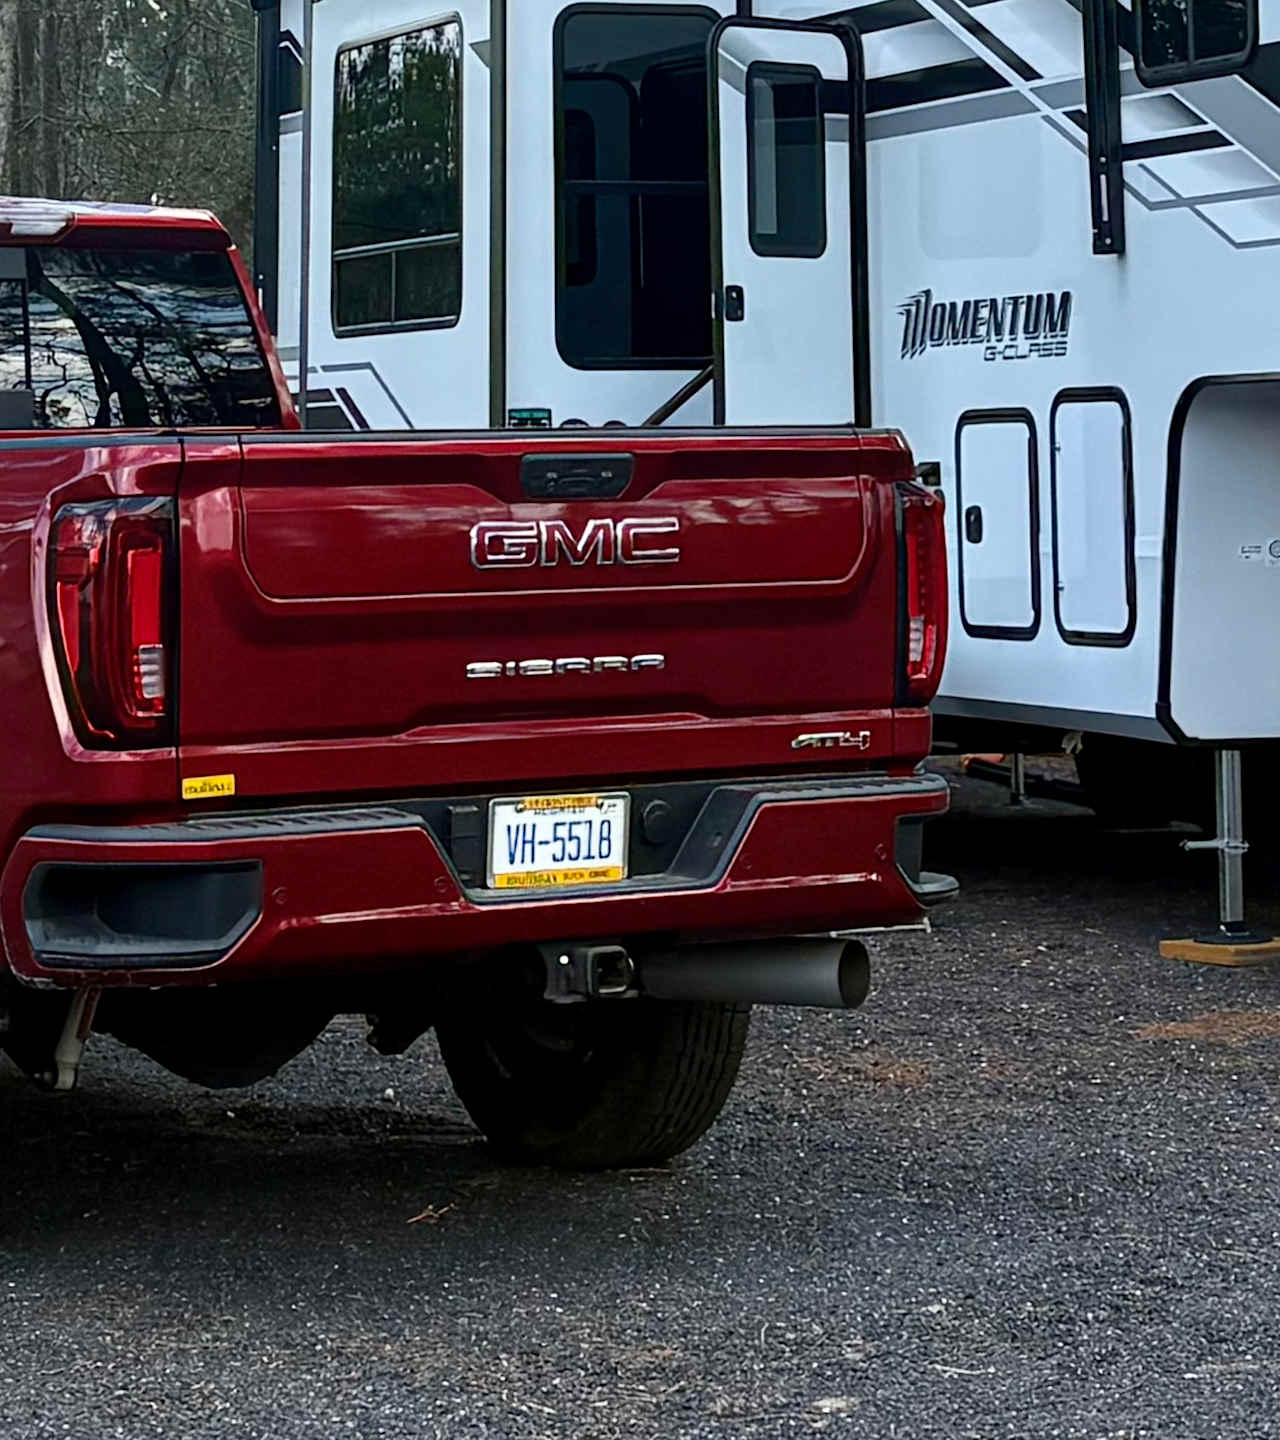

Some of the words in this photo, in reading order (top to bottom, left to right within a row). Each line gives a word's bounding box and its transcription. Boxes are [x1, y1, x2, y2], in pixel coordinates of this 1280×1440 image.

[893, 288, 1072, 361] MOMENTUM
[983, 340, 1069, 362] G-CLASS
[469, 516, 681, 569] GMC
[465, 653, 666, 679] SIERRA
[790, 729, 872, 751] AT4
[505, 818, 612, 866] VH-5518
